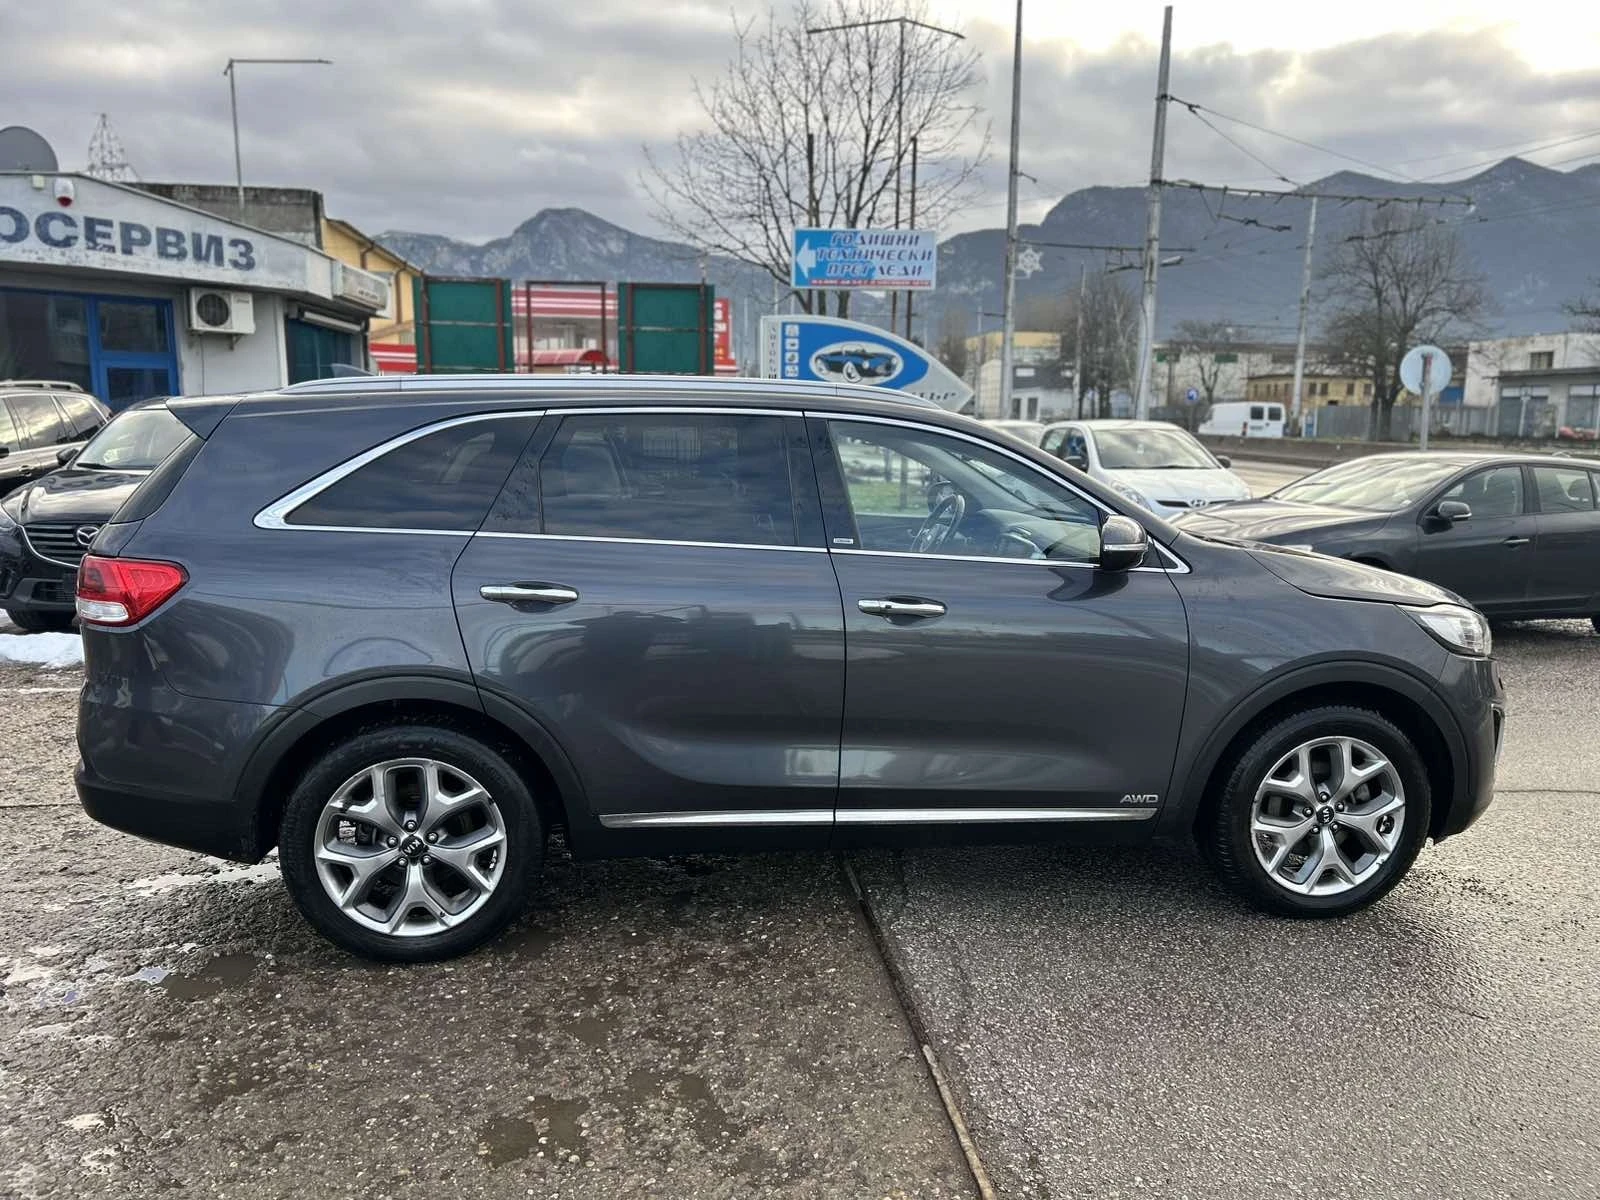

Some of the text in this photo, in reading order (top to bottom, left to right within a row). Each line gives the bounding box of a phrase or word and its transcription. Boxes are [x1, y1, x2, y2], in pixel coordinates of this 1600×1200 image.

[831, 232, 920, 246] ГОДИШНИ
[817, 248, 932, 261] ТЕХНИЧЕСКИ
[826, 263, 922, 276] ПРЕГЛЕДИ
[1120, 794, 1158, 803] AWD
[1322, 808, 1330, 824] KIA
[404, 839, 421, 854] KIA
